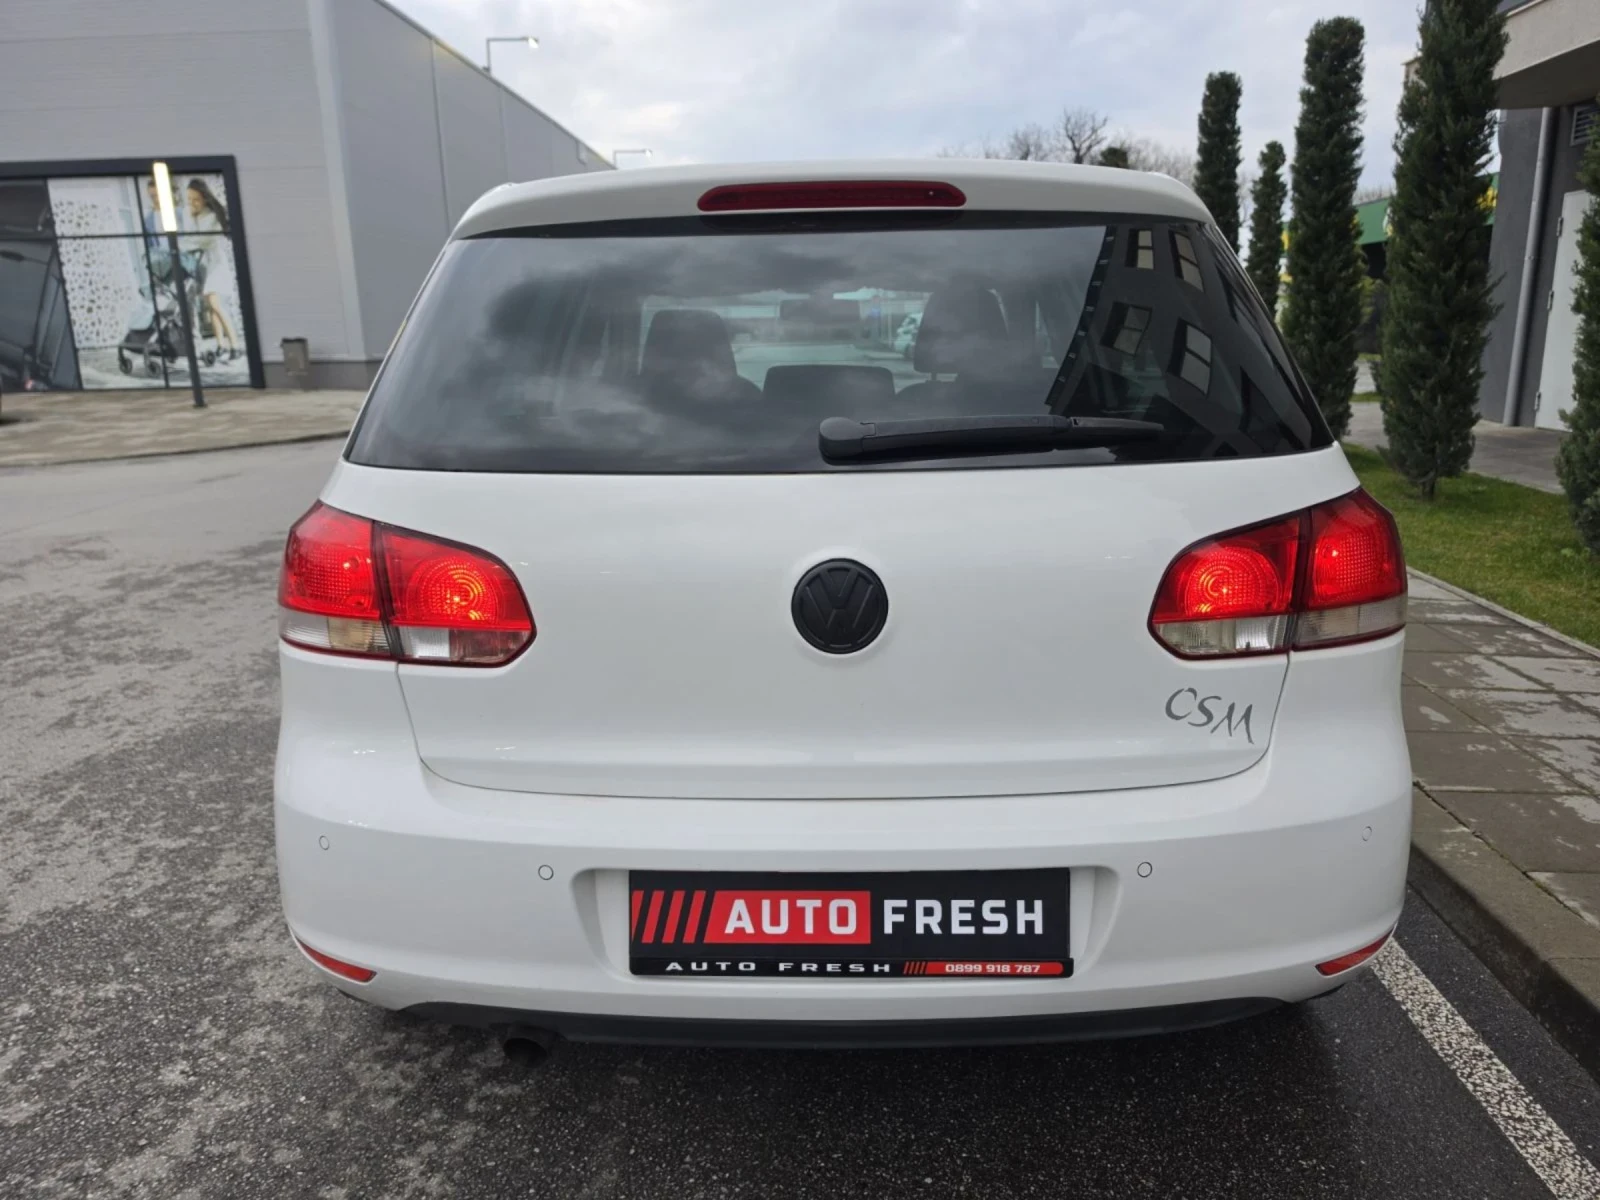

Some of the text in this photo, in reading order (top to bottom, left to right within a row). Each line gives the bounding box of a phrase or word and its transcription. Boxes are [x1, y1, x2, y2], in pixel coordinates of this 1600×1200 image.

[797, 563, 882, 649] VW
[724, 898, 1044, 935] AUTO FRESH
[665, 960, 891, 974] AUTO FRESH
[945, 964, 1041, 973] 0899 918 787
